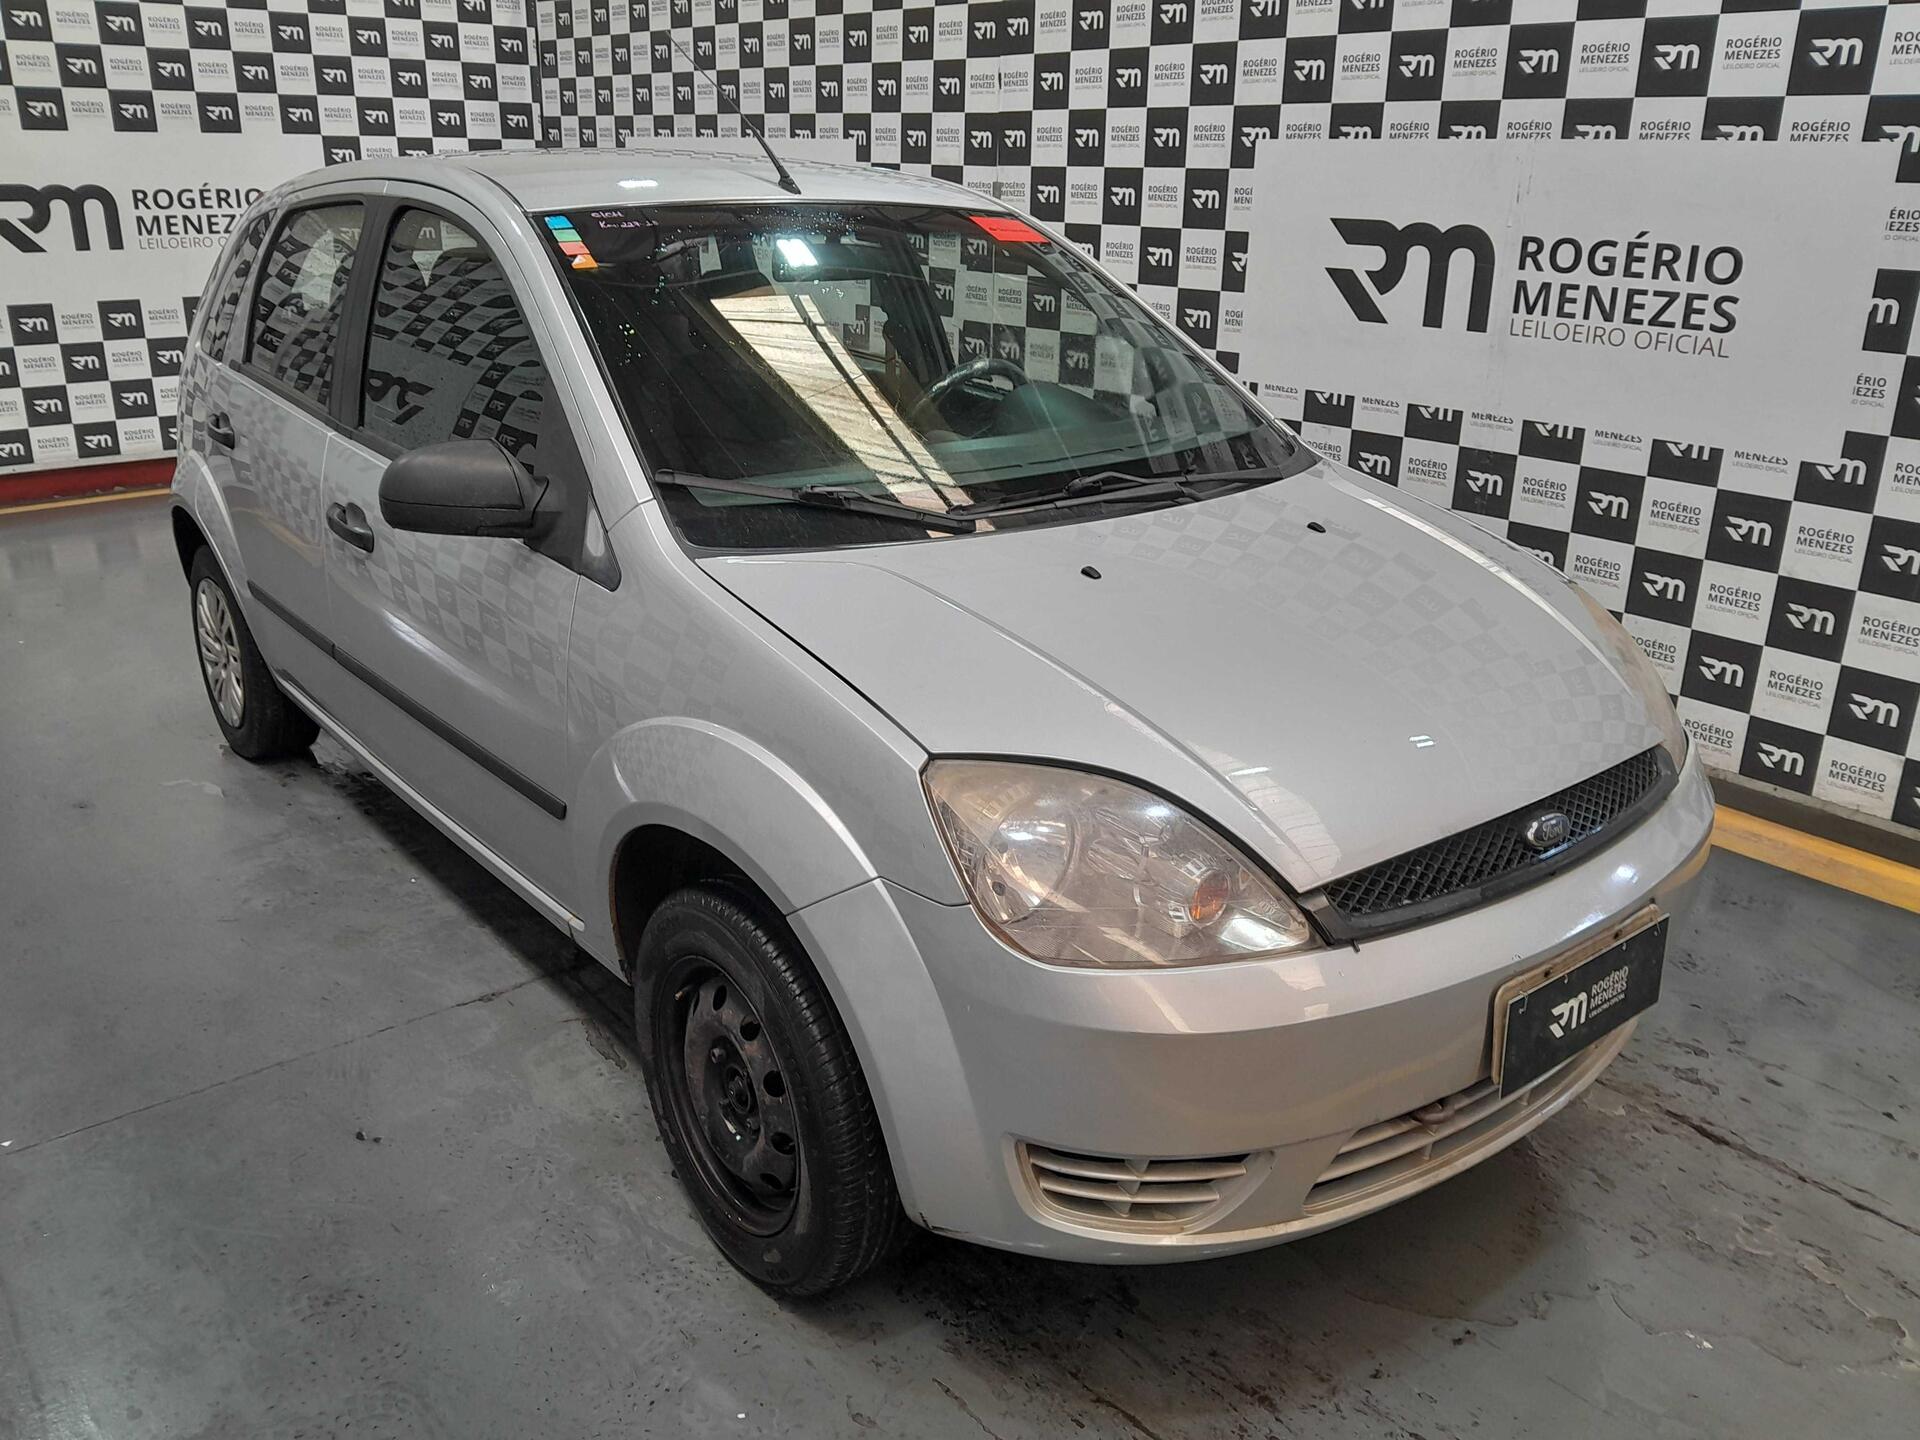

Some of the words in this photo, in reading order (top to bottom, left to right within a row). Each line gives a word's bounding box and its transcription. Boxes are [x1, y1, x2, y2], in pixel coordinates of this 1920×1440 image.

[1116, 2, 1146, 13] ROGÉRIO
[1040, 9, 1066, 20] ROGÉRIO
[1116, 12, 1145, 22] MENEZES
[1039, 18, 1066, 28] MENEZES
[1581, 40, 1630, 54] ROGÉRIO
[1726, 35, 1782, 49] ROGÉRIO
[1342, 51, 1381, 63] ROGÉRIO
[1454, 46, 1497, 58] ROGÉRIO
[1724, 48, 1781, 60] MENEZES
[1243, 57, 1277, 68] ROGÉRIO
[1453, 58, 1497, 69] MENEZES
[1580, 53, 1630, 65] MENEZES
[1075, 65, 1103, 75] ROGÉRIO
[1154, 61, 1185, 72] ROGÉRIO
[1242, 67, 1277, 77] MENEZES
[1341, 62, 1380, 73] MENEZES
[1074, 75, 1102, 84] MENEZES
[1154, 71, 1185, 80] MENEZES
[1036, 125, 1062, 134] ROGÉRIO
[1111, 124, 1140, 133] ROGÉRIO
[1193, 122, 1225, 132] ROGÉRIO
[1286, 121, 1322, 132] ROGÉRIO
[1389, 120, 1430, 131] ROGÉRIO
[1507, 119, 1552, 131] ROGÉRIO
[1639, 118, 1691, 131] ROGÉRIO
[1791, 118, 1850, 132] ROGÉRIO
[1036, 134, 1062, 142] MENEZES
[1110, 133, 1140, 142] MENEZES
[1193, 132, 1225, 141] MENEZES
[1070, 182, 1098, 192] ROGÉRIO
[1148, 184, 1178, 194] ROGÉRIO
[1070, 190, 1098, 200] MENEZES
[1147, 193, 1178, 202] MENEZES
[1889, 206, 1920, 221] ÉRIO
[138, 237, 214, 250] LEILOEIRO
[1106, 241, 1134, 251] ROGÉRIO
[1105, 249, 1134, 259] MENEZES
[1186, 246, 1217, 256] ROGÉRIO
[1185, 254, 1216, 265] MENEZES
[1518, 231, 1744, 285] ROGÉRIO
[1512, 280, 1739, 334] MENEZES
[1509, 318, 1626, 348] LEILOEIRO
[1634, 330, 1730, 358] OFICIAL
[1856, 372, 1887, 388] ÉRIO
[1408, 457, 1447, 471] ROGÉRIO
[1407, 465, 1446, 480] MENEZES
[1523, 476, 1567, 492] ROGÉRIO
[1522, 485, 1566, 501] MENEZES
[1651, 499, 1701, 516] ROGÉRIO
[1650, 508, 1700, 526] MENEZES
[1798, 525, 1855, 544] ROGÉRIO
[1796, 535, 1853, 555] MENEZES
[1575, 554, 1620, 572] ROGÉRIO
[1573, 563, 1620, 581] MENEZES
[1709, 583, 1761, 602] ROGÉRIO
[1707, 592, 1760, 612] MENEZES
[1863, 615, 1920, 637] ROGÉRIO
[1860, 626, 1919, 648] MENEZES
[1768, 669, 1823, 691] ROGÉRIO
[1766, 679, 1822, 701] MENEZES
[1684, 718, 1734, 739] ROGÉRIO
[1693, 730, 1733, 749] ENEZES
[1830, 759, 1887, 783] ROGÉRIO
[1828, 769, 1886, 793] MENEZES
[1542, 820, 1563, 841] Ford
[1591, 966, 1629, 998] ROGÉRIO
[1589, 980, 1627, 1009] MENEZES
